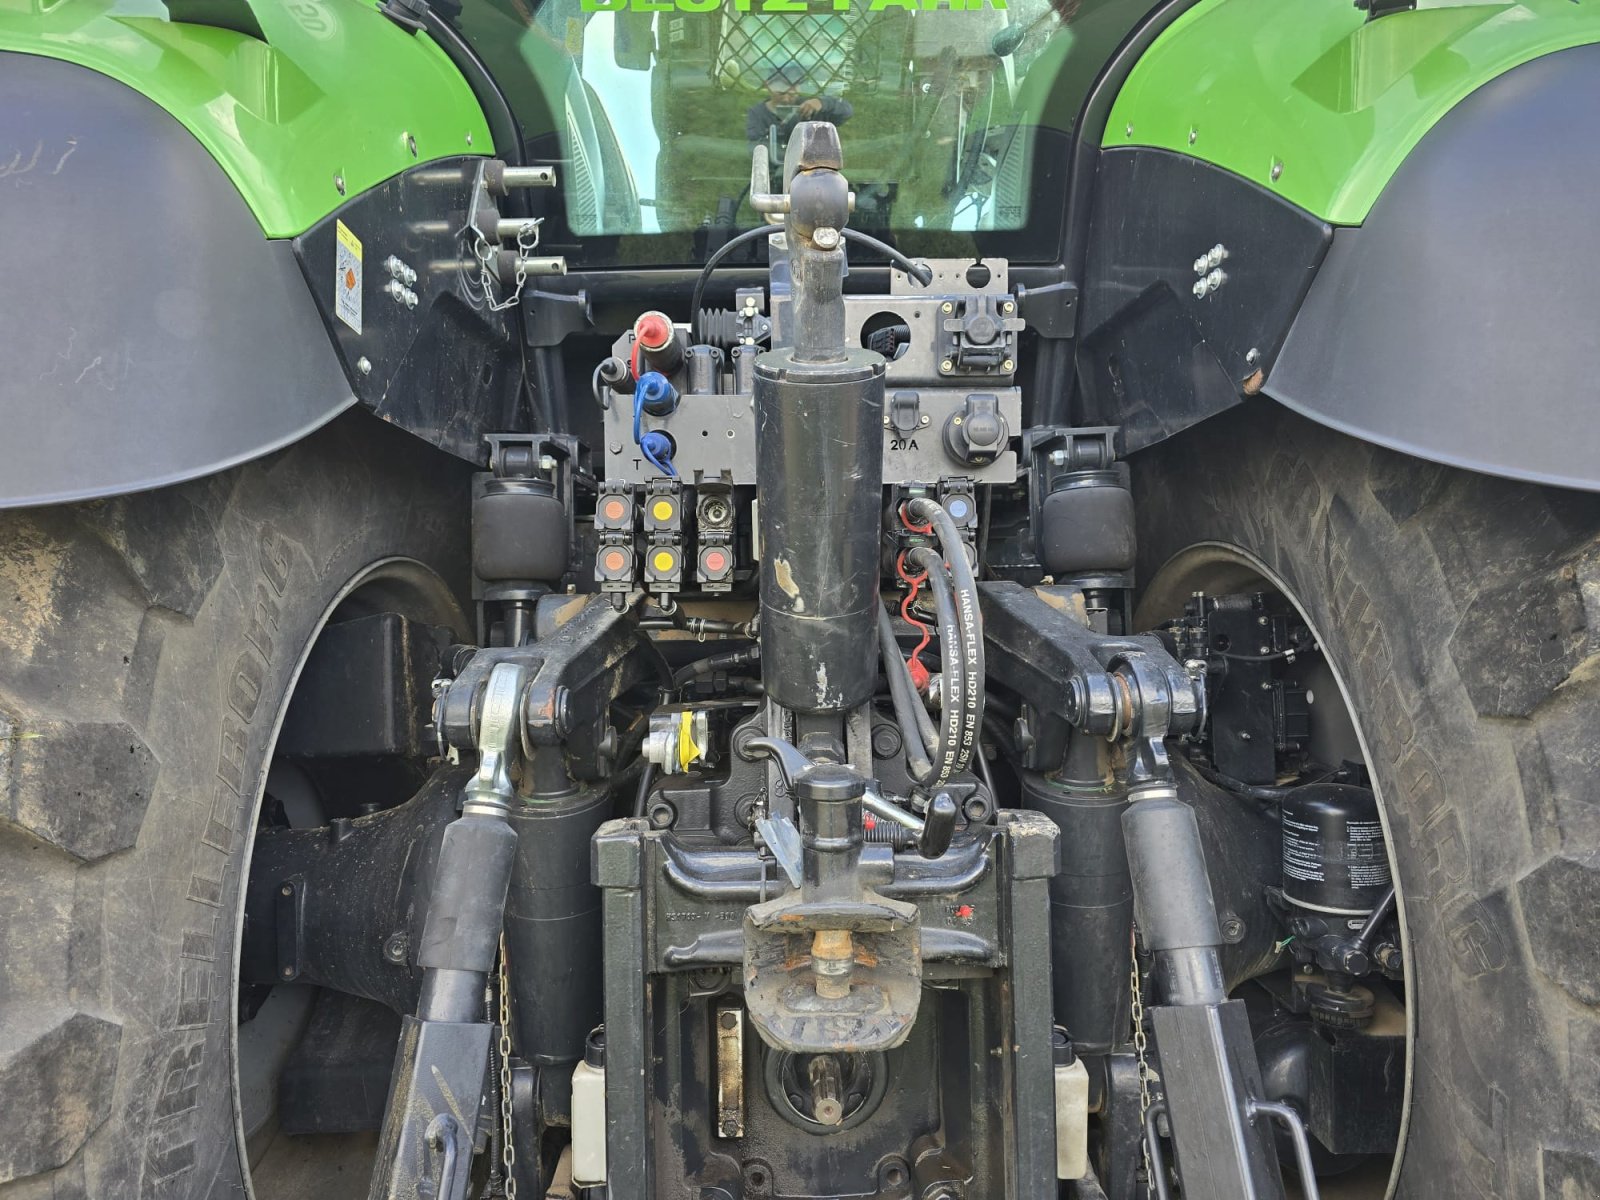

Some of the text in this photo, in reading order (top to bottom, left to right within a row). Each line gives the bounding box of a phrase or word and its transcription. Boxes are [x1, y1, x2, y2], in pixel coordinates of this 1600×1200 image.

[633, 459, 641, 470] T
[961, 589, 977, 665] HANSA-FLEX
[946, 624, 960, 703] HANSA-FLEX
[967, 672, 977, 709] HD210
[947, 709, 959, 746] HD210
[965, 714, 975, 729] EN
[963, 730, 973, 746] 853
[944, 751, 955, 764] EN
[940, 765, 951, 778] 853
[146, 519, 294, 1186] TRELLEBORG
